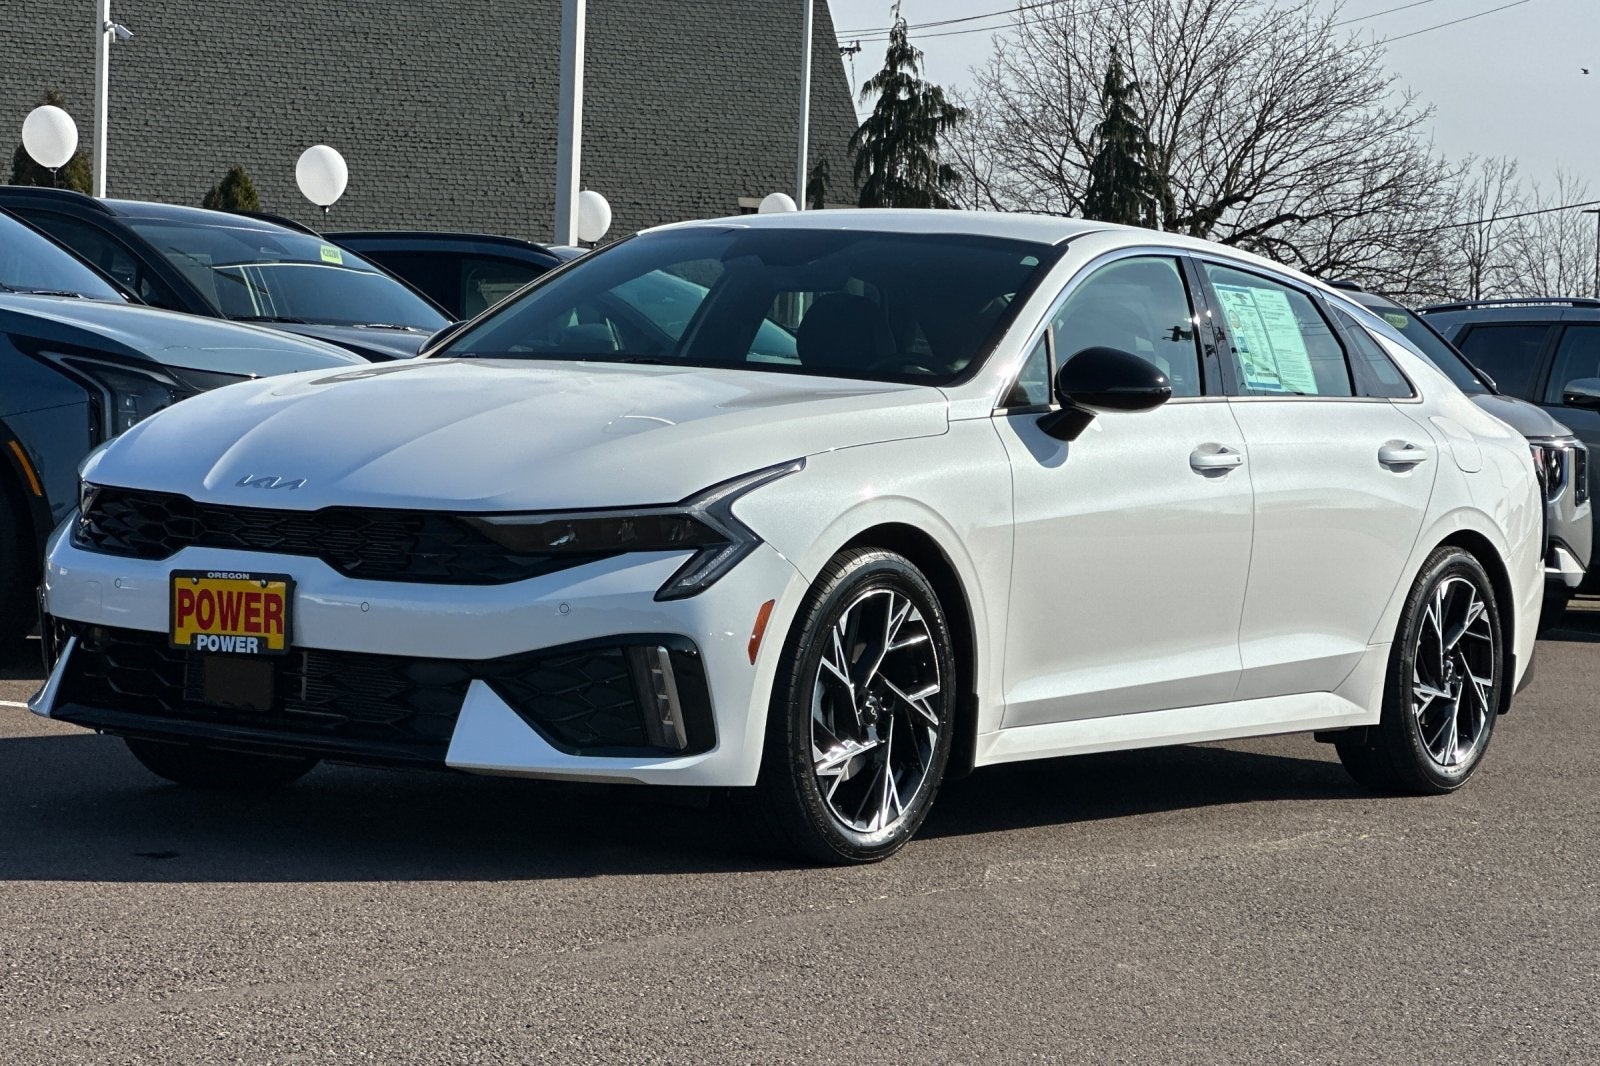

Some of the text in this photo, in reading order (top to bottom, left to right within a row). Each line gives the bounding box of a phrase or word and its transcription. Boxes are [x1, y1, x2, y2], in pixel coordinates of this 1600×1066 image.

[207, 572, 250, 580] OREGON
[178, 588, 284, 635] POWER
[197, 634, 258, 654] POWER
